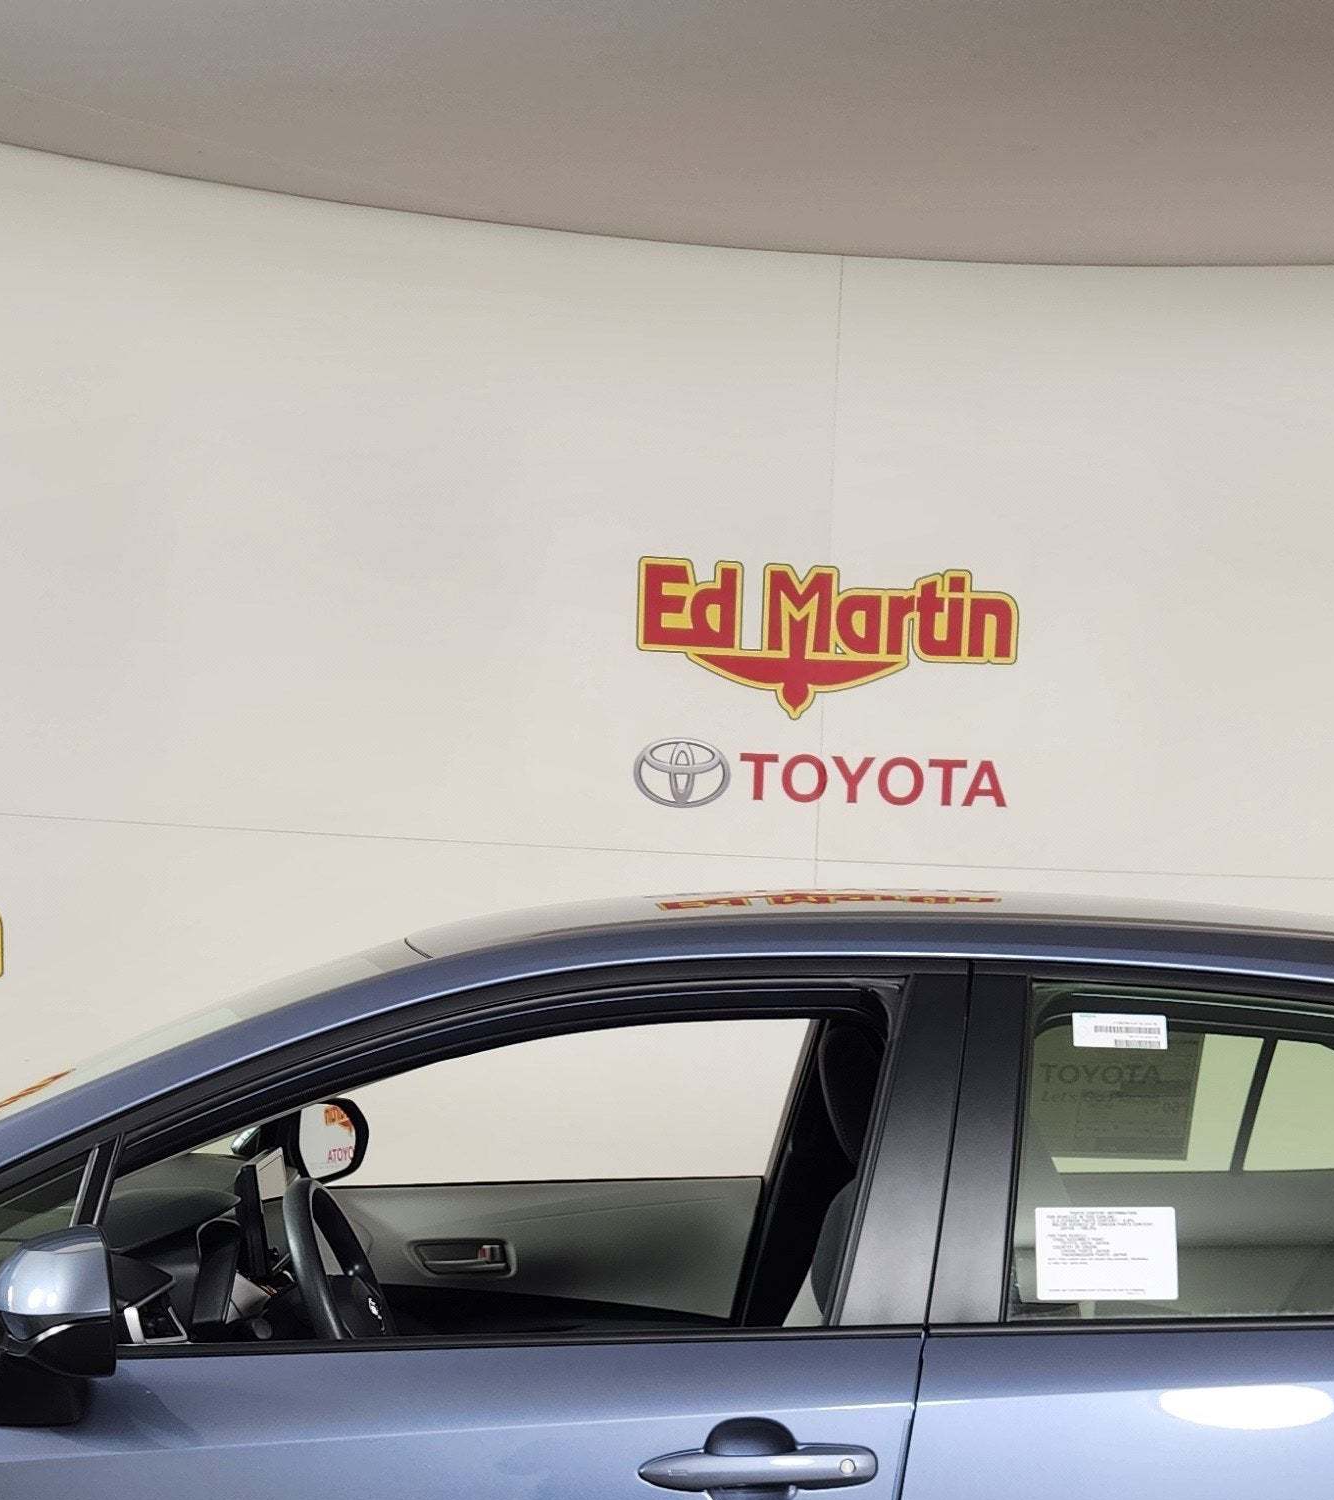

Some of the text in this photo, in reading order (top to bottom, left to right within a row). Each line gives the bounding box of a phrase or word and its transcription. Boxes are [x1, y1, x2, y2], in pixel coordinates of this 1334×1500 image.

[641, 562, 1013, 660] Ed Martin
[739, 752, 1008, 808] TOYOTA
[1039, 1063, 1162, 1085] TOYOTA
